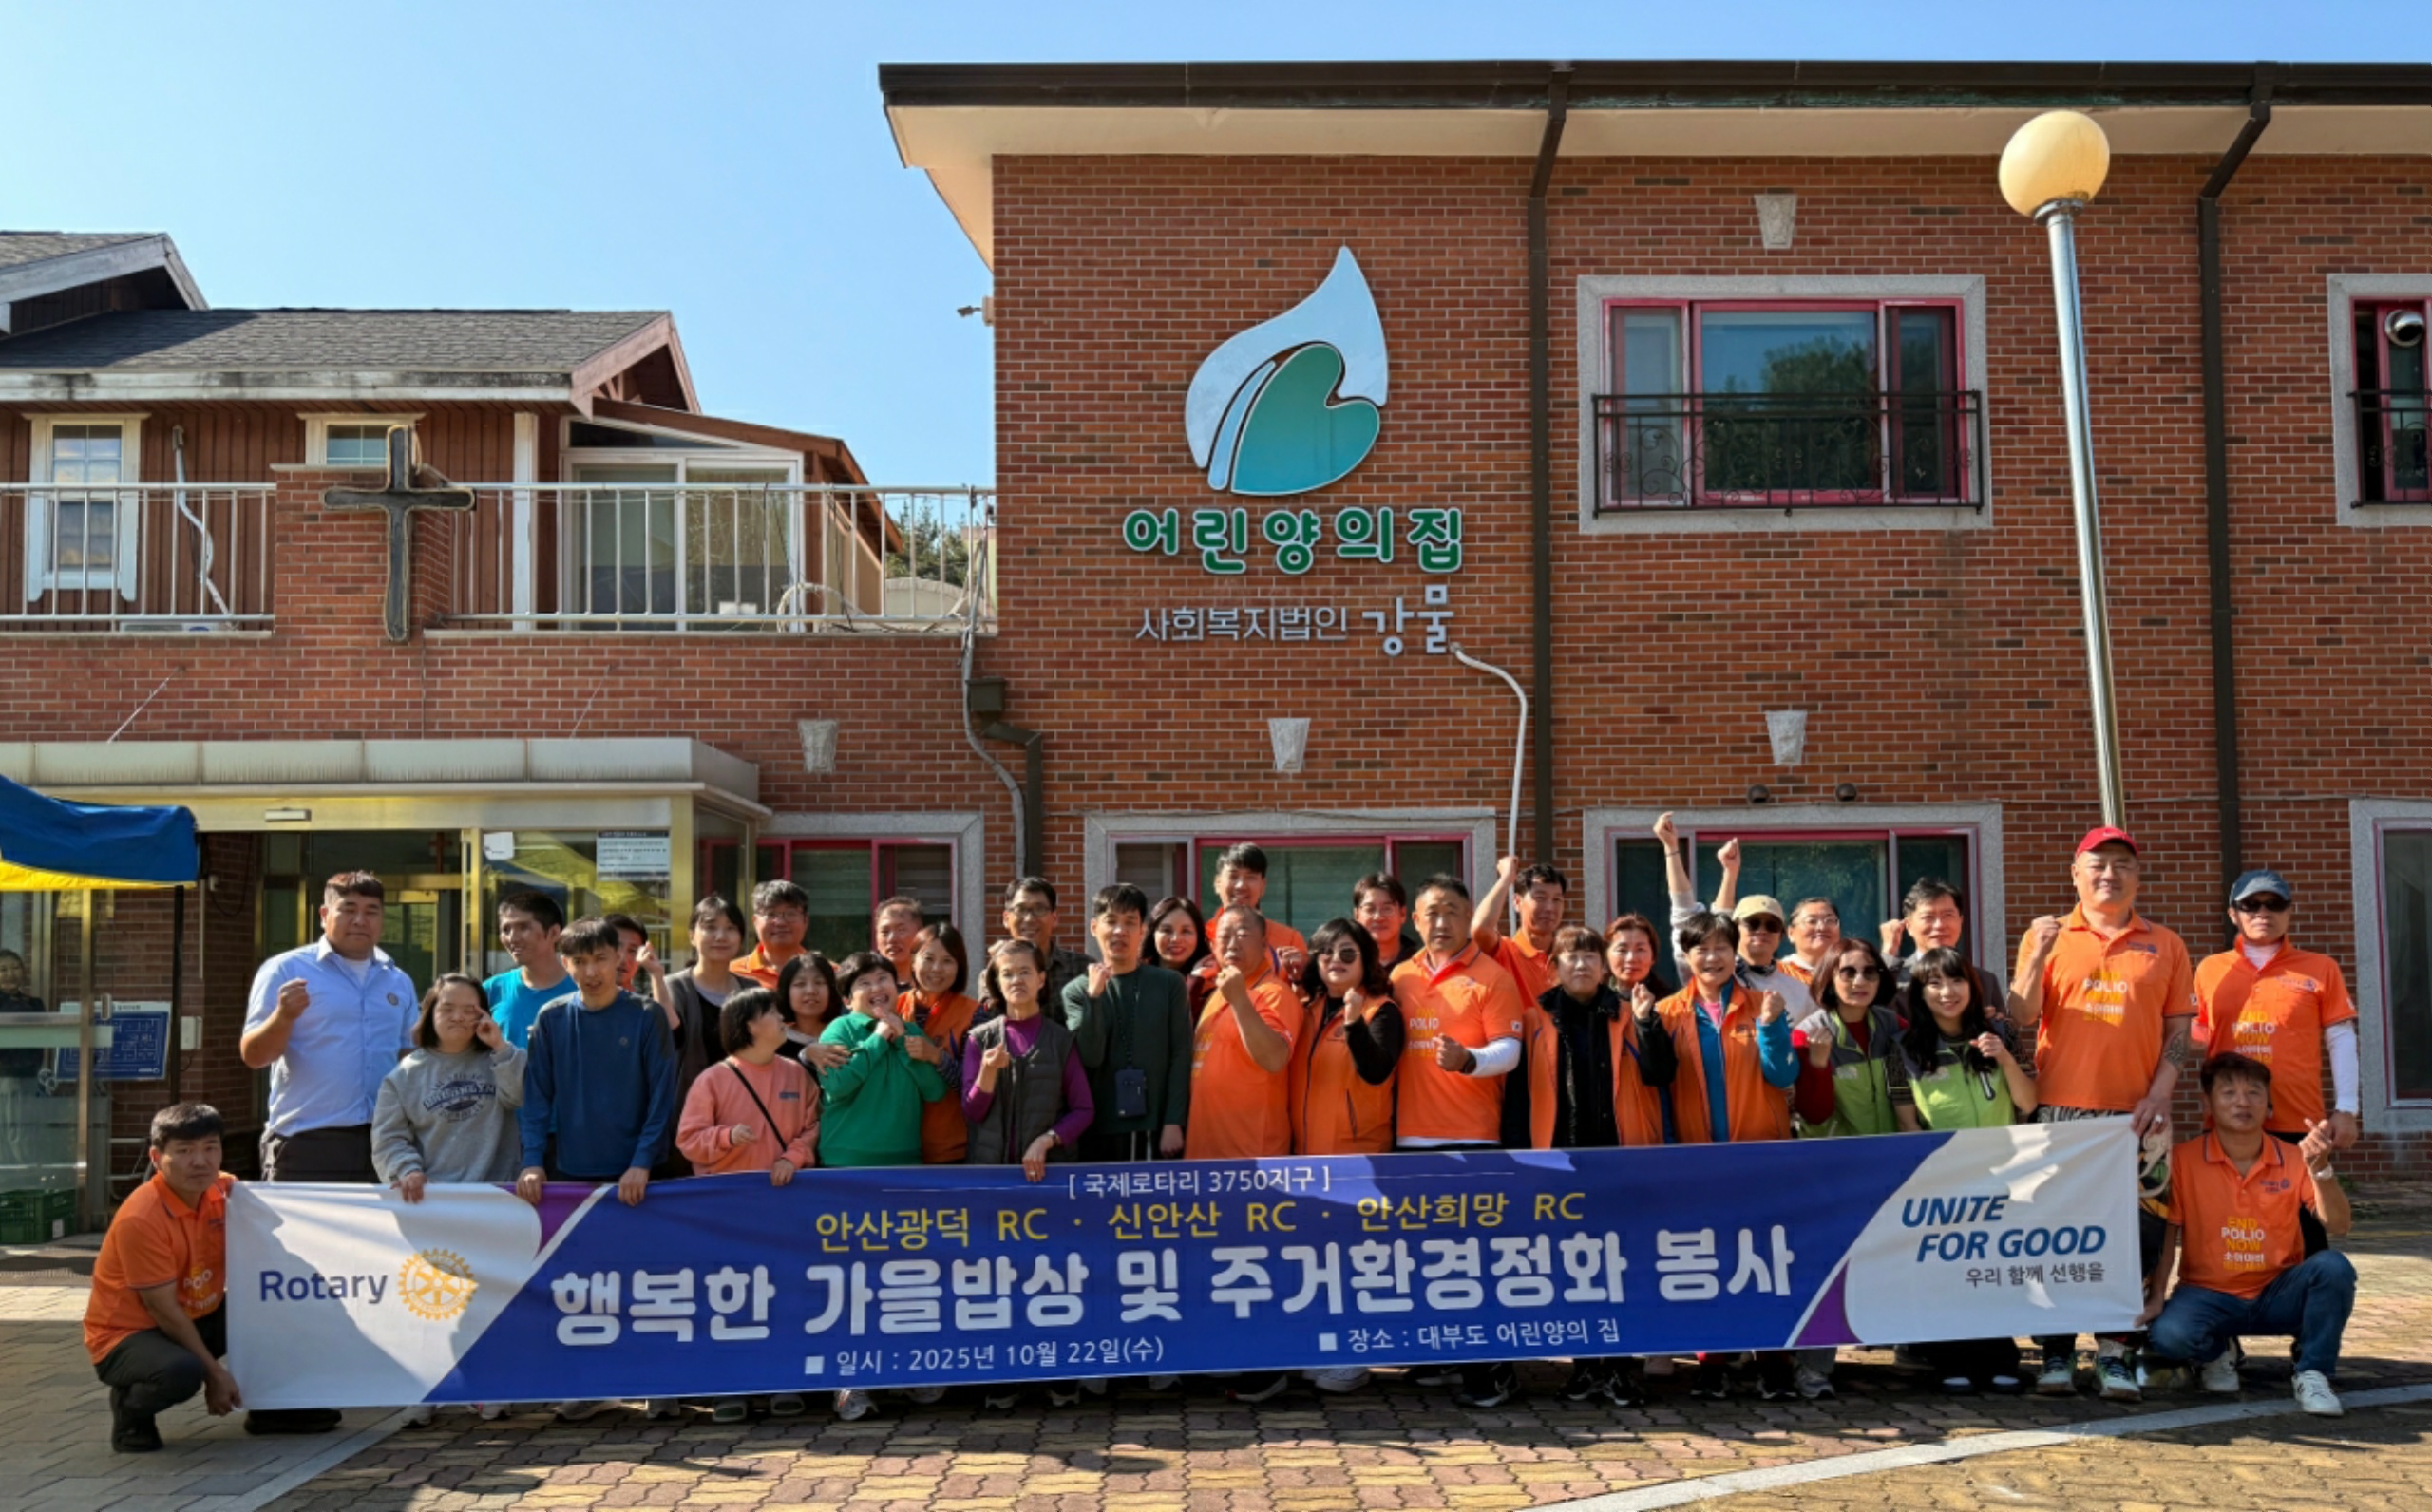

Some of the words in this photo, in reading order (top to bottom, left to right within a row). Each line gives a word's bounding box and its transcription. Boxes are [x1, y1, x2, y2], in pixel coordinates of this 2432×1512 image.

[1123, 506, 1463, 575] 어린양의집
[1135, 606, 1348, 642] 사회복지법인
[1361, 584, 1454, 655] 강물
[1083, 1170, 1200, 1198] 국제로타리
[1208, 1167, 1316, 1193] 3750지구
[816, 1207, 970, 1253] 안산광덕
[998, 1208, 1049, 1241] RC
[1107, 1200, 1222, 1240] 신안산
[1246, 1200, 1298, 1232] RC
[1356, 1192, 1510, 1232] 안산희망
[1533, 1192, 1586, 1221] RC
[1901, 1194, 2010, 1228] UNITE
[1916, 1230, 1990, 1263] FOR
[1998, 1225, 2107, 1258] GOOD
[2220, 1226, 2266, 1242] POLIO
[259, 1270, 388, 1304] Rotary
[550, 1264, 776, 1346] 행복한
[804, 1251, 1090, 1337] 가을밥상
[1116, 1247, 1183, 1324] 및
[1209, 1231, 1628, 1319] 주거환경정화
[1655, 1224, 1795, 1302] 봉사
[1966, 1267, 2002, 1287] 우리
[2007, 1264, 2044, 1286] 함께
[2050, 1261, 2105, 1283] 선행을
[1348, 1327, 1395, 1353] 장소
[1417, 1323, 1489, 1351] 대부도
[1496, 1319, 1589, 1348] 어린양의
[1598, 1318, 1621, 1344] 집
[836, 1350, 883, 1376] 일시
[908, 1344, 996, 1372] 2025년
[1006, 1340, 1058, 1368] 10월
[1068, 1336, 1165, 1365] 22일(수)
